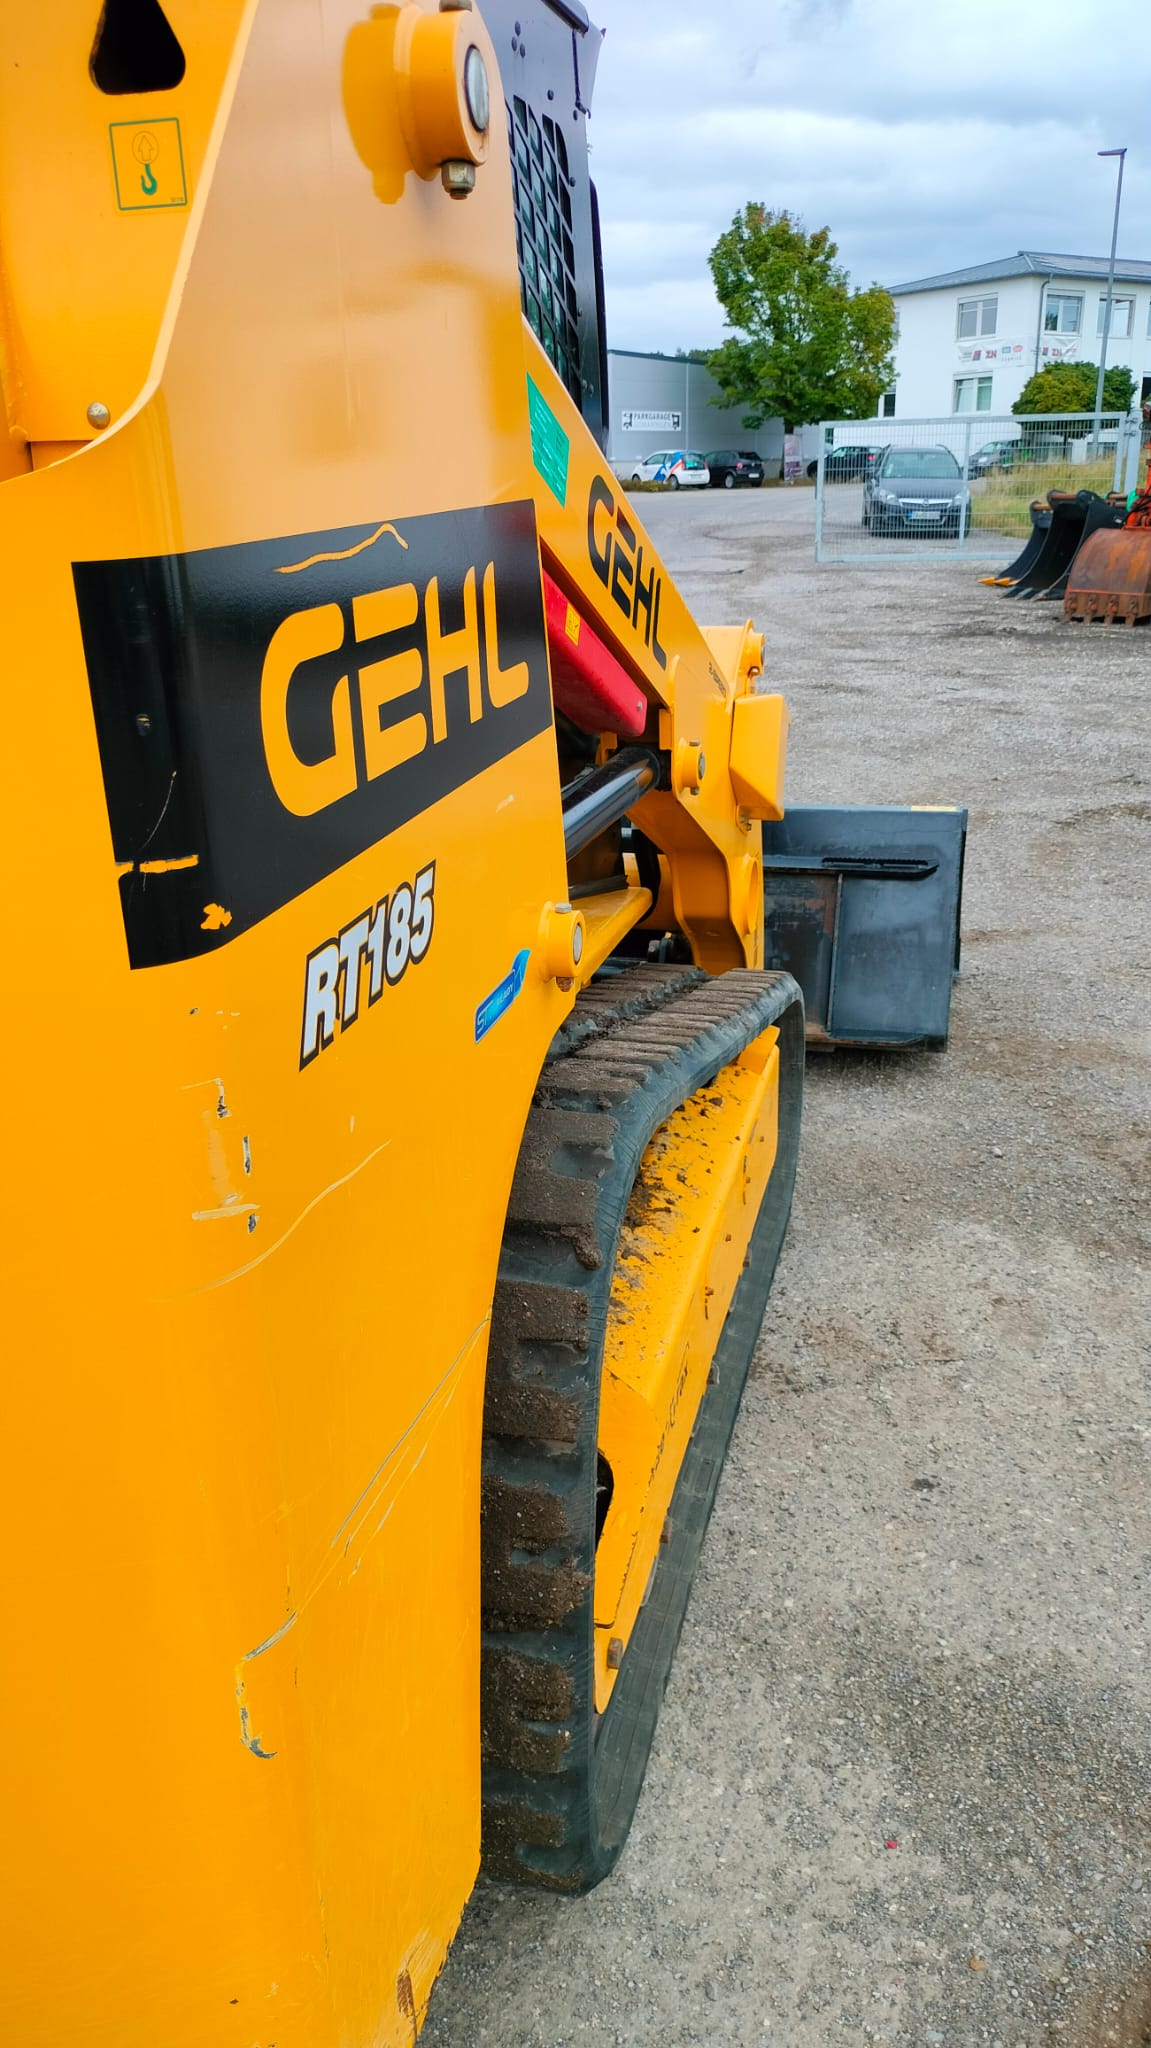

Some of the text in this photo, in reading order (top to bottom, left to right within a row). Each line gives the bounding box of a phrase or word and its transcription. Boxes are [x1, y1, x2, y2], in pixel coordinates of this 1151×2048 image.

[587, 474, 667, 672] GEHL
[260, 560, 530, 817] GEHL
[299, 859, 437, 1072] RT185
